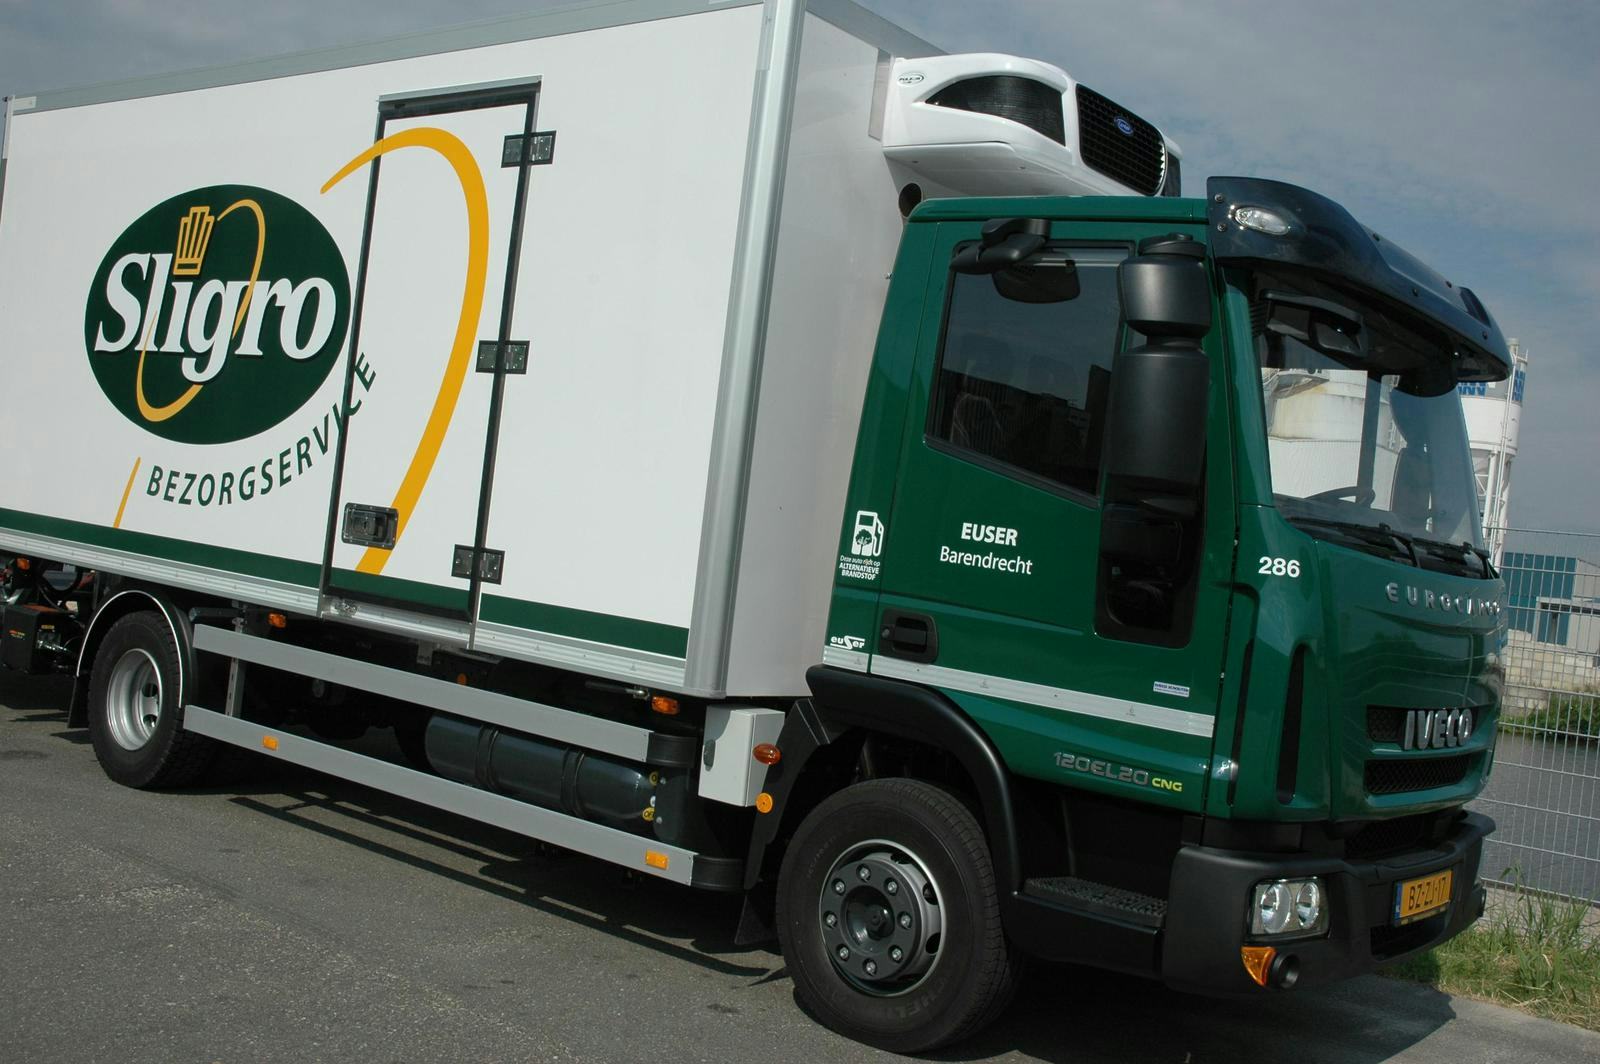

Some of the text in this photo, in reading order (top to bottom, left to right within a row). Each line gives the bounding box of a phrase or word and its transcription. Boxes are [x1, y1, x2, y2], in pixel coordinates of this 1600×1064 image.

[94, 252, 337, 382] Sligro
[960, 522, 1018, 546] EUSER
[839, 562, 880, 574] ALTERNATIEVE
[939, 546, 1033, 575] Barendrecht
[1258, 556, 1301, 578] 286
[841, 570, 876, 580] BRANDSTOF
[1403, 707, 1473, 751] IVECO
[1053, 751, 1183, 793] 120EL20 CNG
